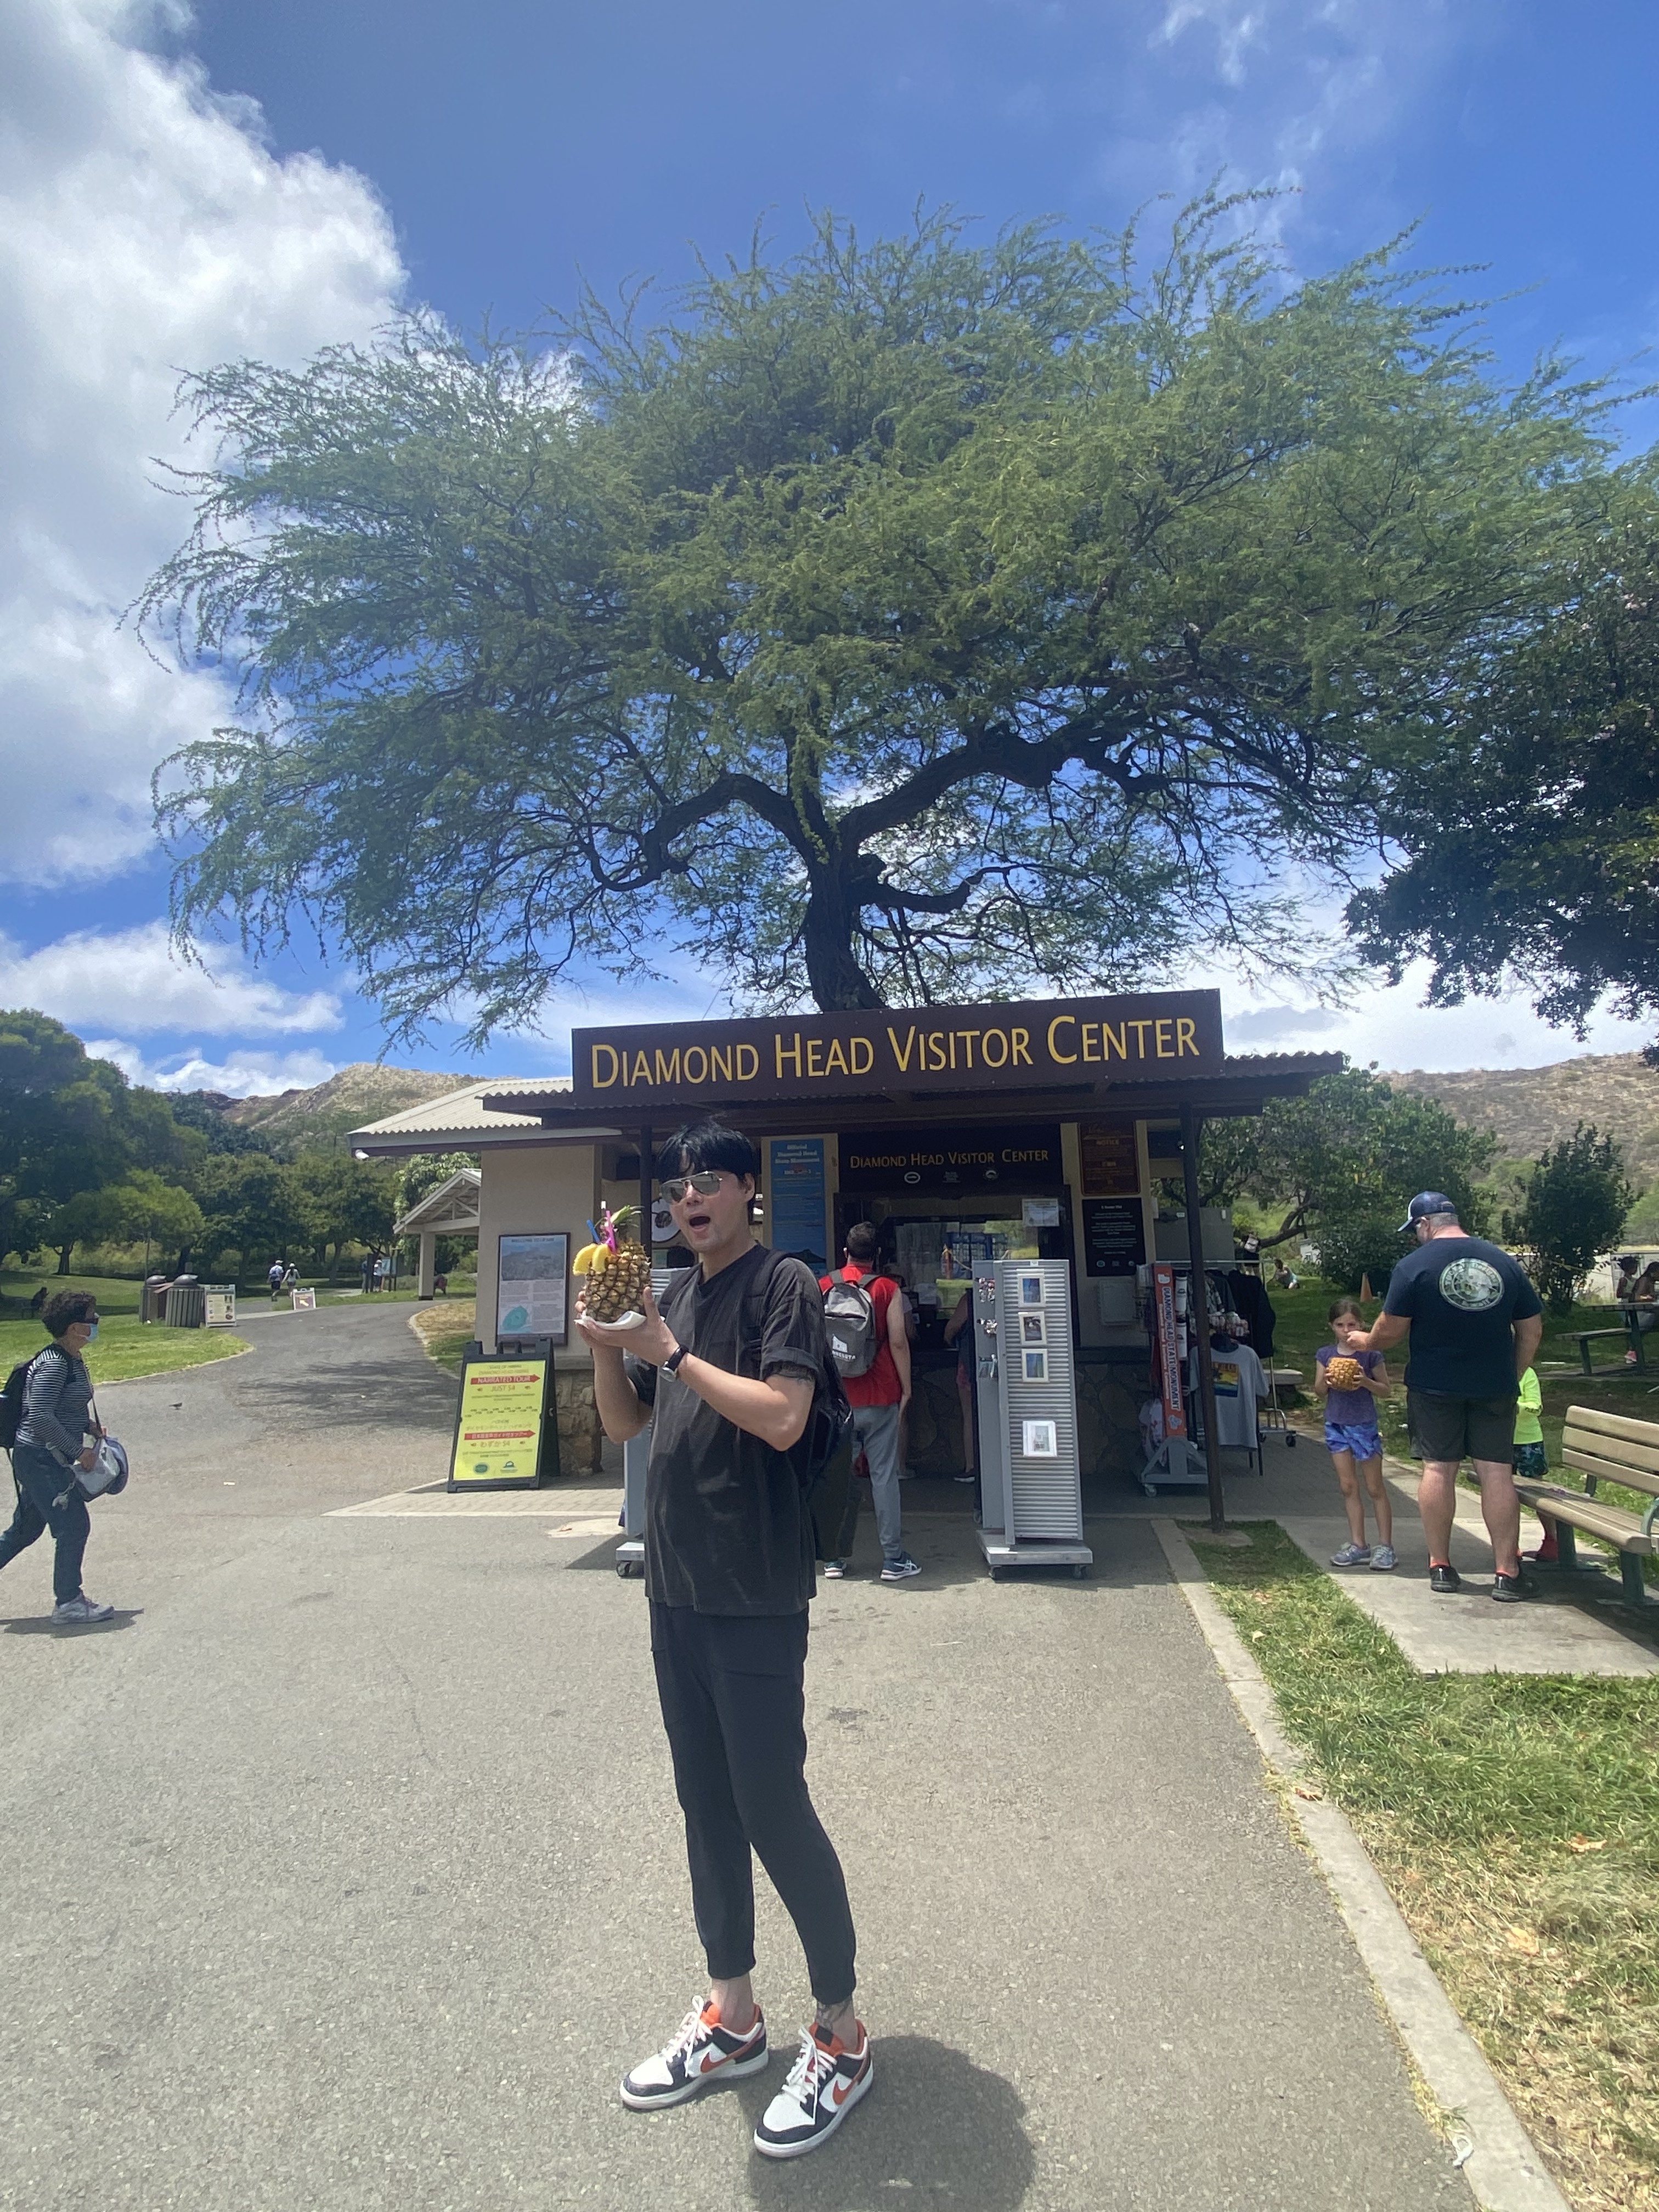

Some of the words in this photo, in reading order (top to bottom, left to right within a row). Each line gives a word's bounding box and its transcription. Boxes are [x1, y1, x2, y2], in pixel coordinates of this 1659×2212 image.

[591, 1043, 760, 1088] DIAMOND
[774, 1032, 874, 1079] HEAD
[887, 1025, 1034, 1072] VISITOR
[1047, 1015, 1200, 1064] CENTER
[850, 1155, 907, 1169] DIAMOND
[911, 1153, 944, 1166] HEAD
[948, 1152, 995, 1165] VISITOR
[1002, 1149, 1049, 1163] CENTER
[1163, 1287, 1173, 1321] DIAMOND
[1166, 1321, 1175, 1340] HEAD
[1167, 1342, 1176, 1364] STATE
[1170, 1366, 1180, 1410] MONUMENT
